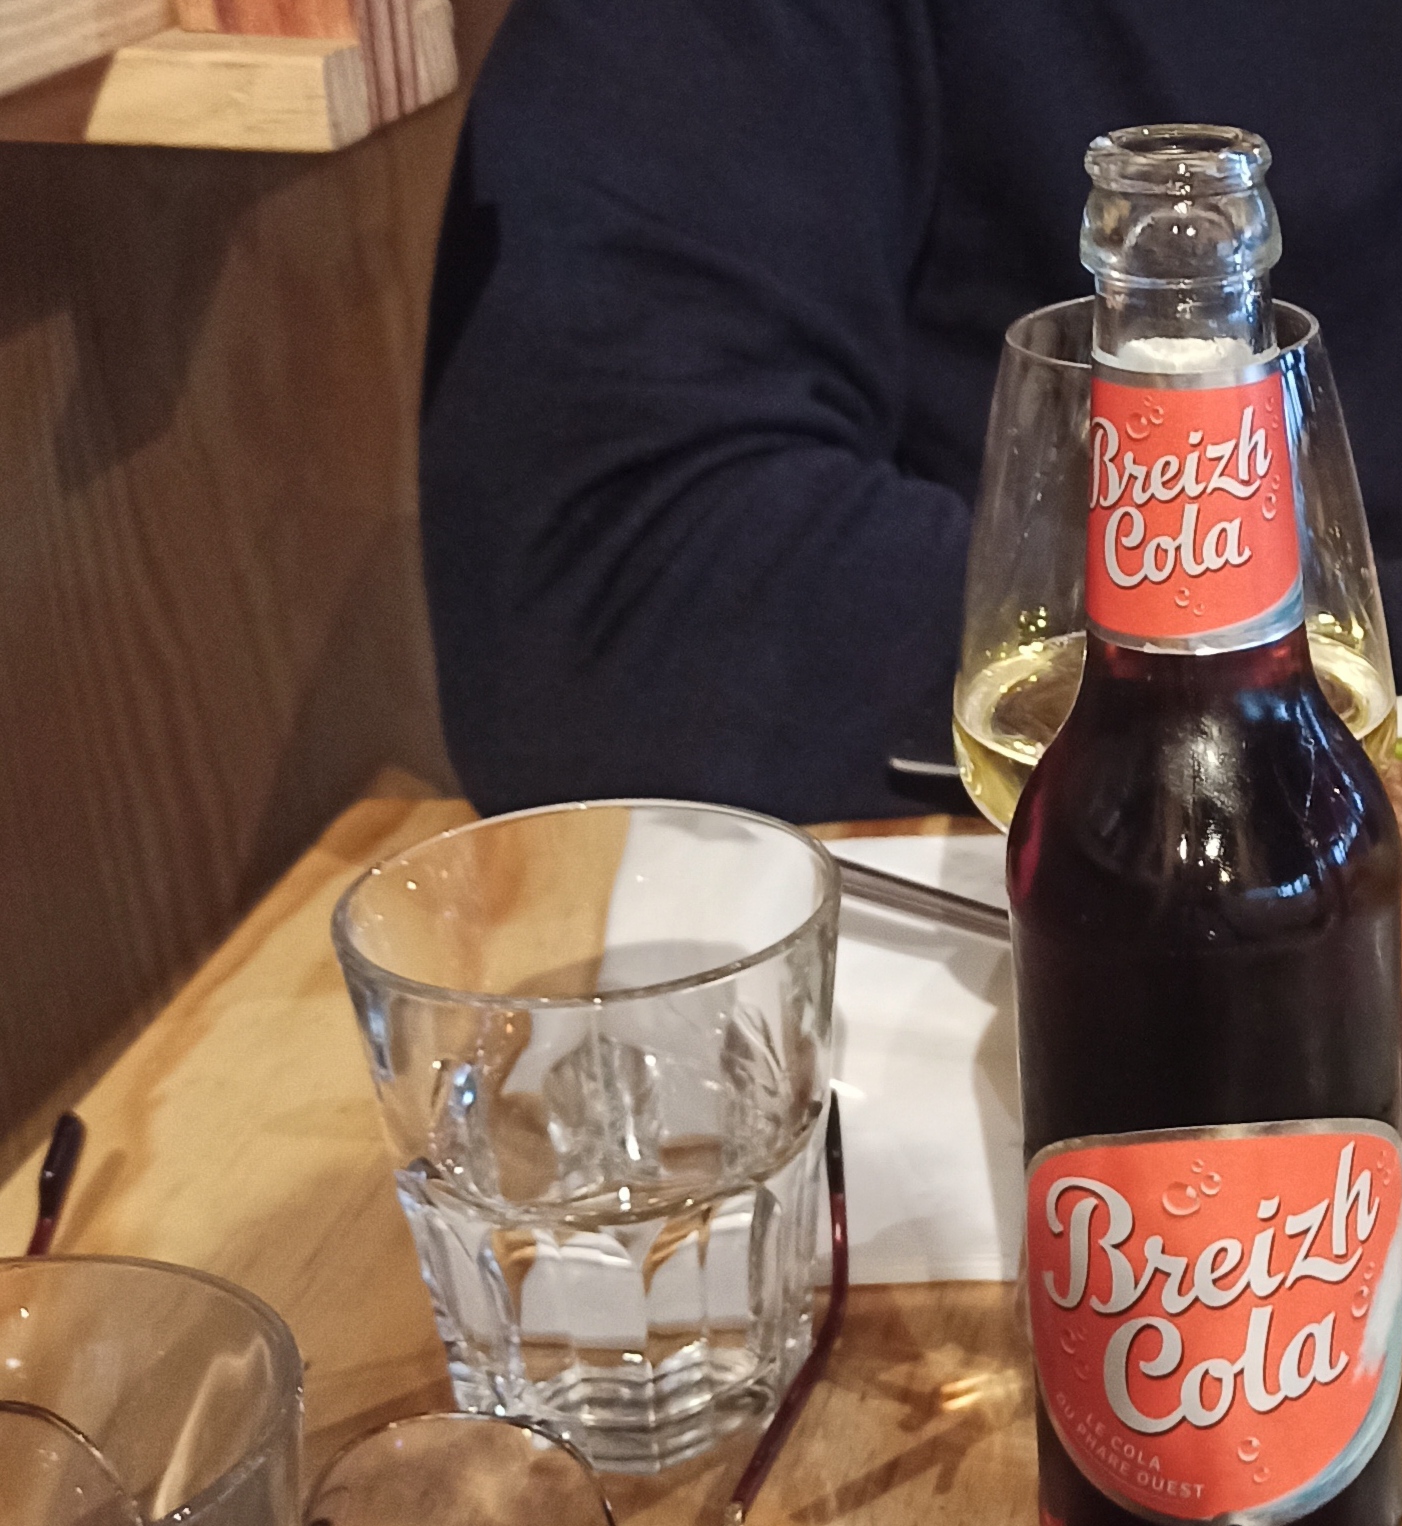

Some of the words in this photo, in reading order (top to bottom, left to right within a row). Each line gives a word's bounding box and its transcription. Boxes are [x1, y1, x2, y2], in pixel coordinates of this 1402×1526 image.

[1089, 405, 1273, 509] Breizh
[1104, 503, 1252, 588] Cola
[1044, 1141, 1379, 1314] Breizh
[1103, 1305, 1350, 1434] Cola
[1077, 1423, 1129, 1474] PHARE
[1137, 1473, 1205, 1499] OUEST
[1086, 1413, 1106, 1436] LE
[1111, 1437, 1160, 1471] COLA
